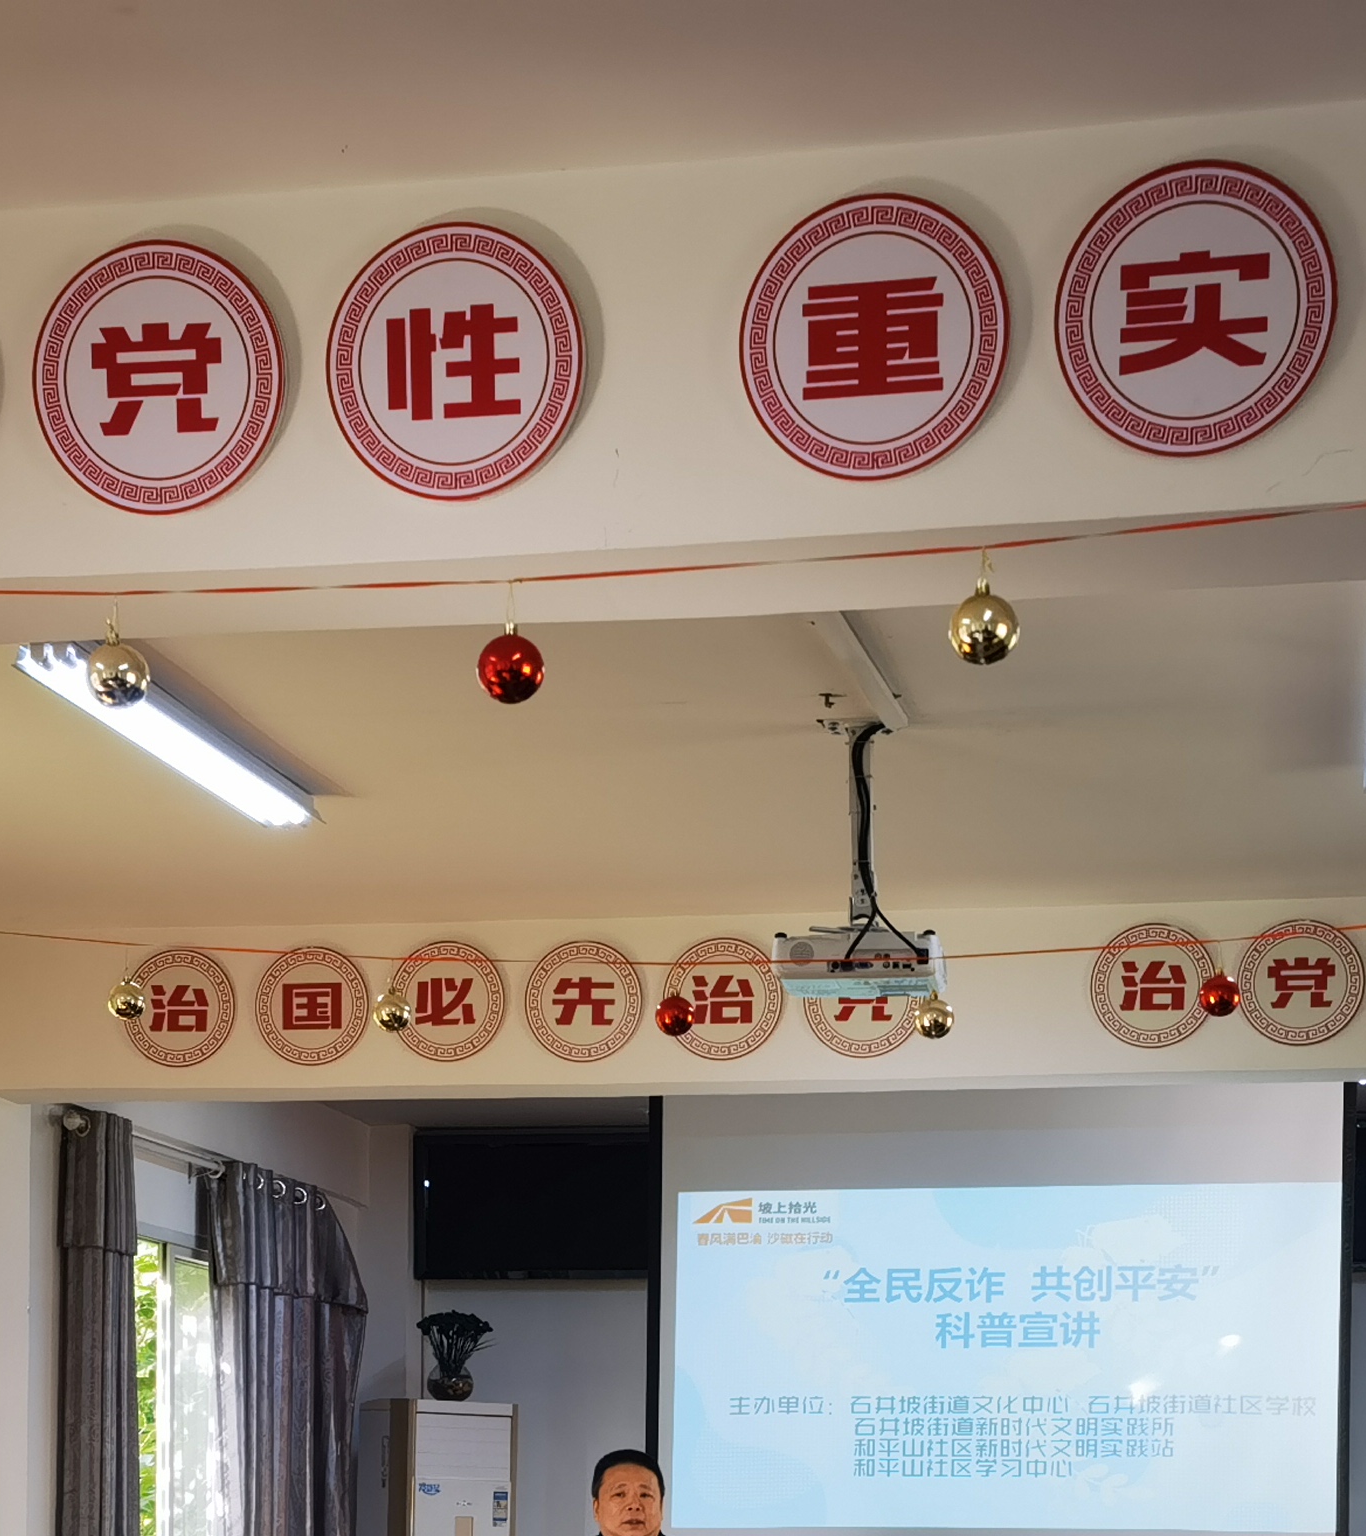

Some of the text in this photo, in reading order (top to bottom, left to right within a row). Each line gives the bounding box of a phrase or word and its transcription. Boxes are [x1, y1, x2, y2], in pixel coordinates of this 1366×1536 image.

[758, 1201, 817, 1215] 坡上拾光
[934, 1310, 1102, 1350] 科普宣讲
[853, 1416, 1175, 1437] 石井坡街道新时代文明实践所
[853, 1437, 1175, 1458] 和平山社区新时代文明实践站
[853, 1458, 1073, 1478] 和平山社区学习中心
